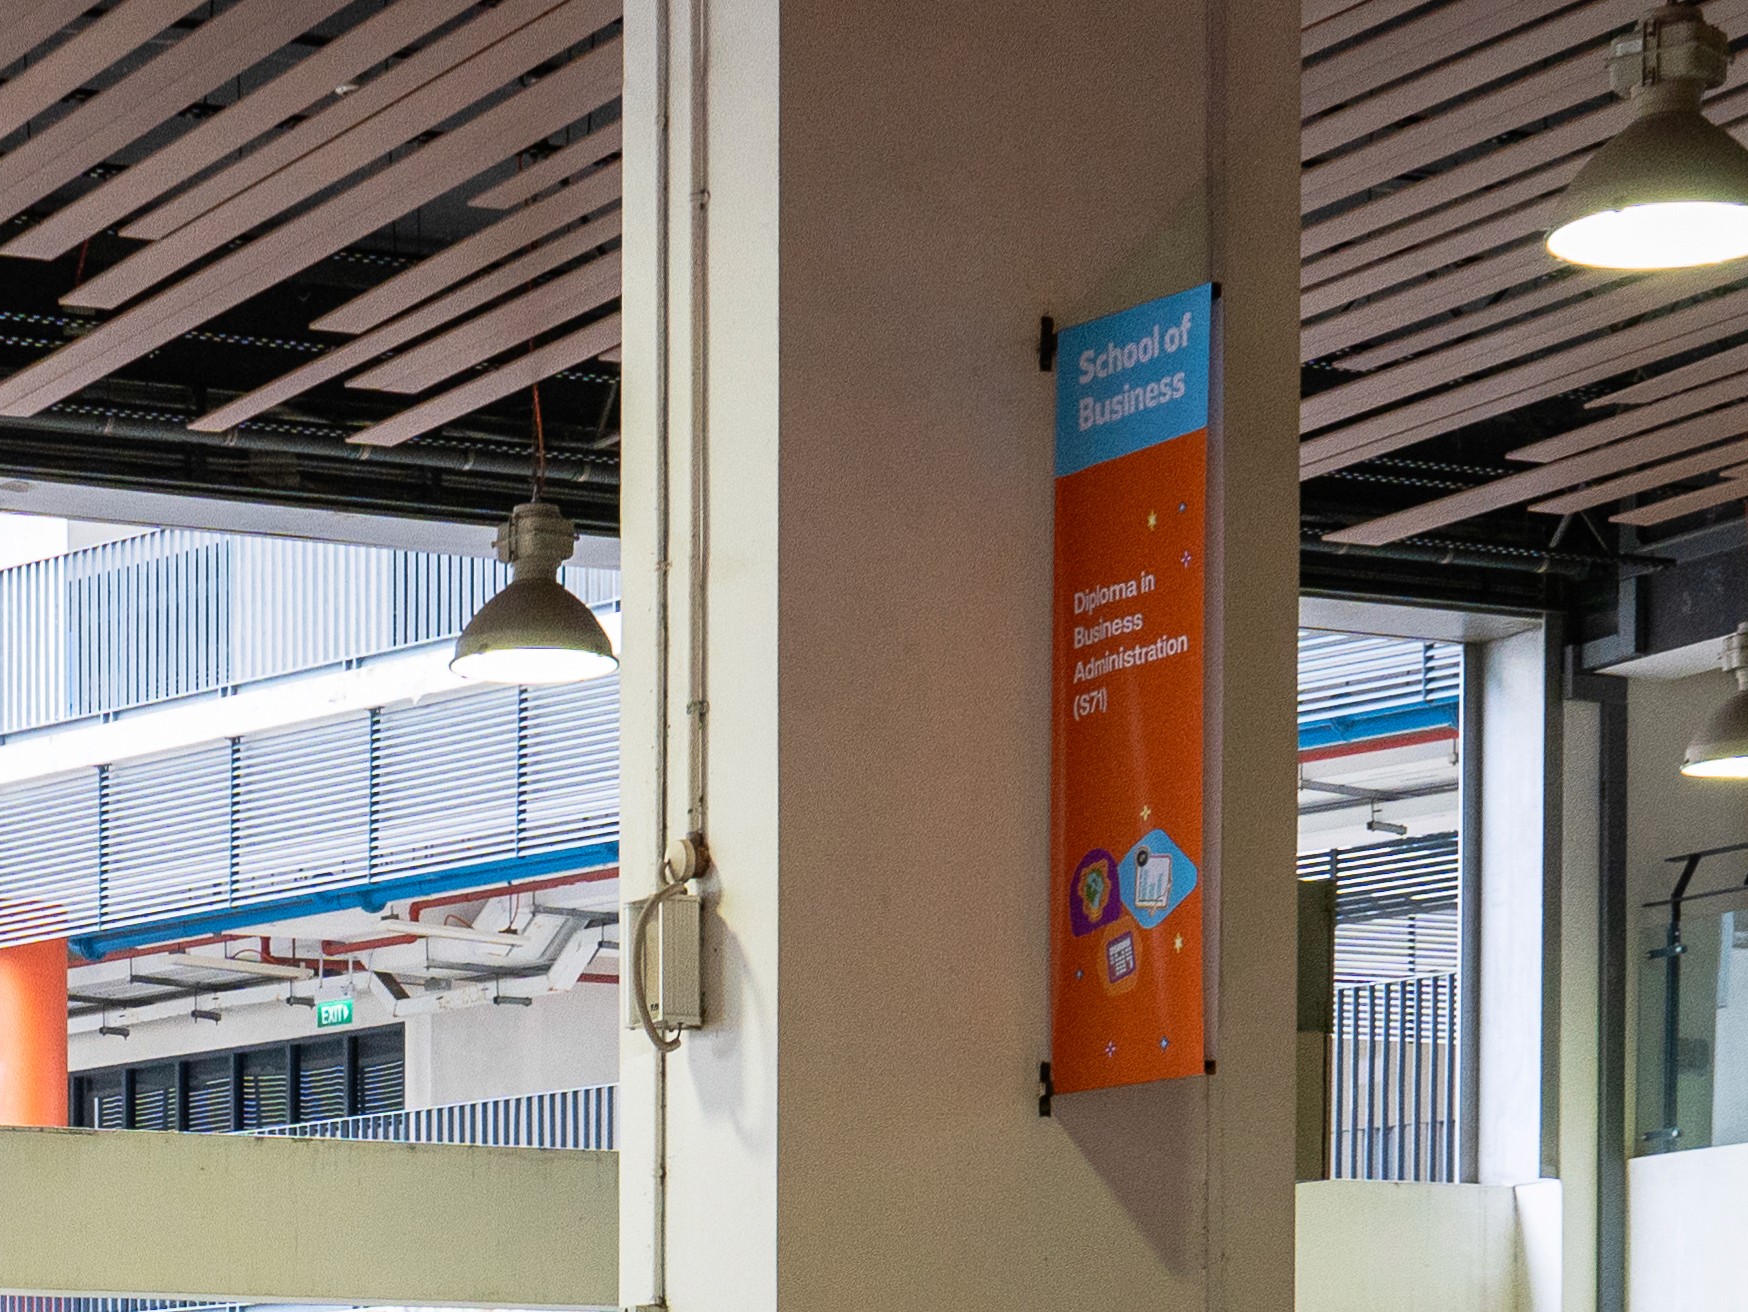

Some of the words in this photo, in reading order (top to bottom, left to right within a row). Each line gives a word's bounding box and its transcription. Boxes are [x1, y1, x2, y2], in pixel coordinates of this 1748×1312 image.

[1079, 324, 1160, 384] School
[1164, 311, 1192, 353] of
[1079, 371, 1186, 432] Business
[1074, 580, 1137, 615] Diploma
[1140, 570, 1156, 594] in
[1074, 612, 1144, 650] Business
[1073, 634, 1190, 684] Administration
[1073, 687, 1108, 721] (S71)
[321, 1004, 344, 1025] EXIT
